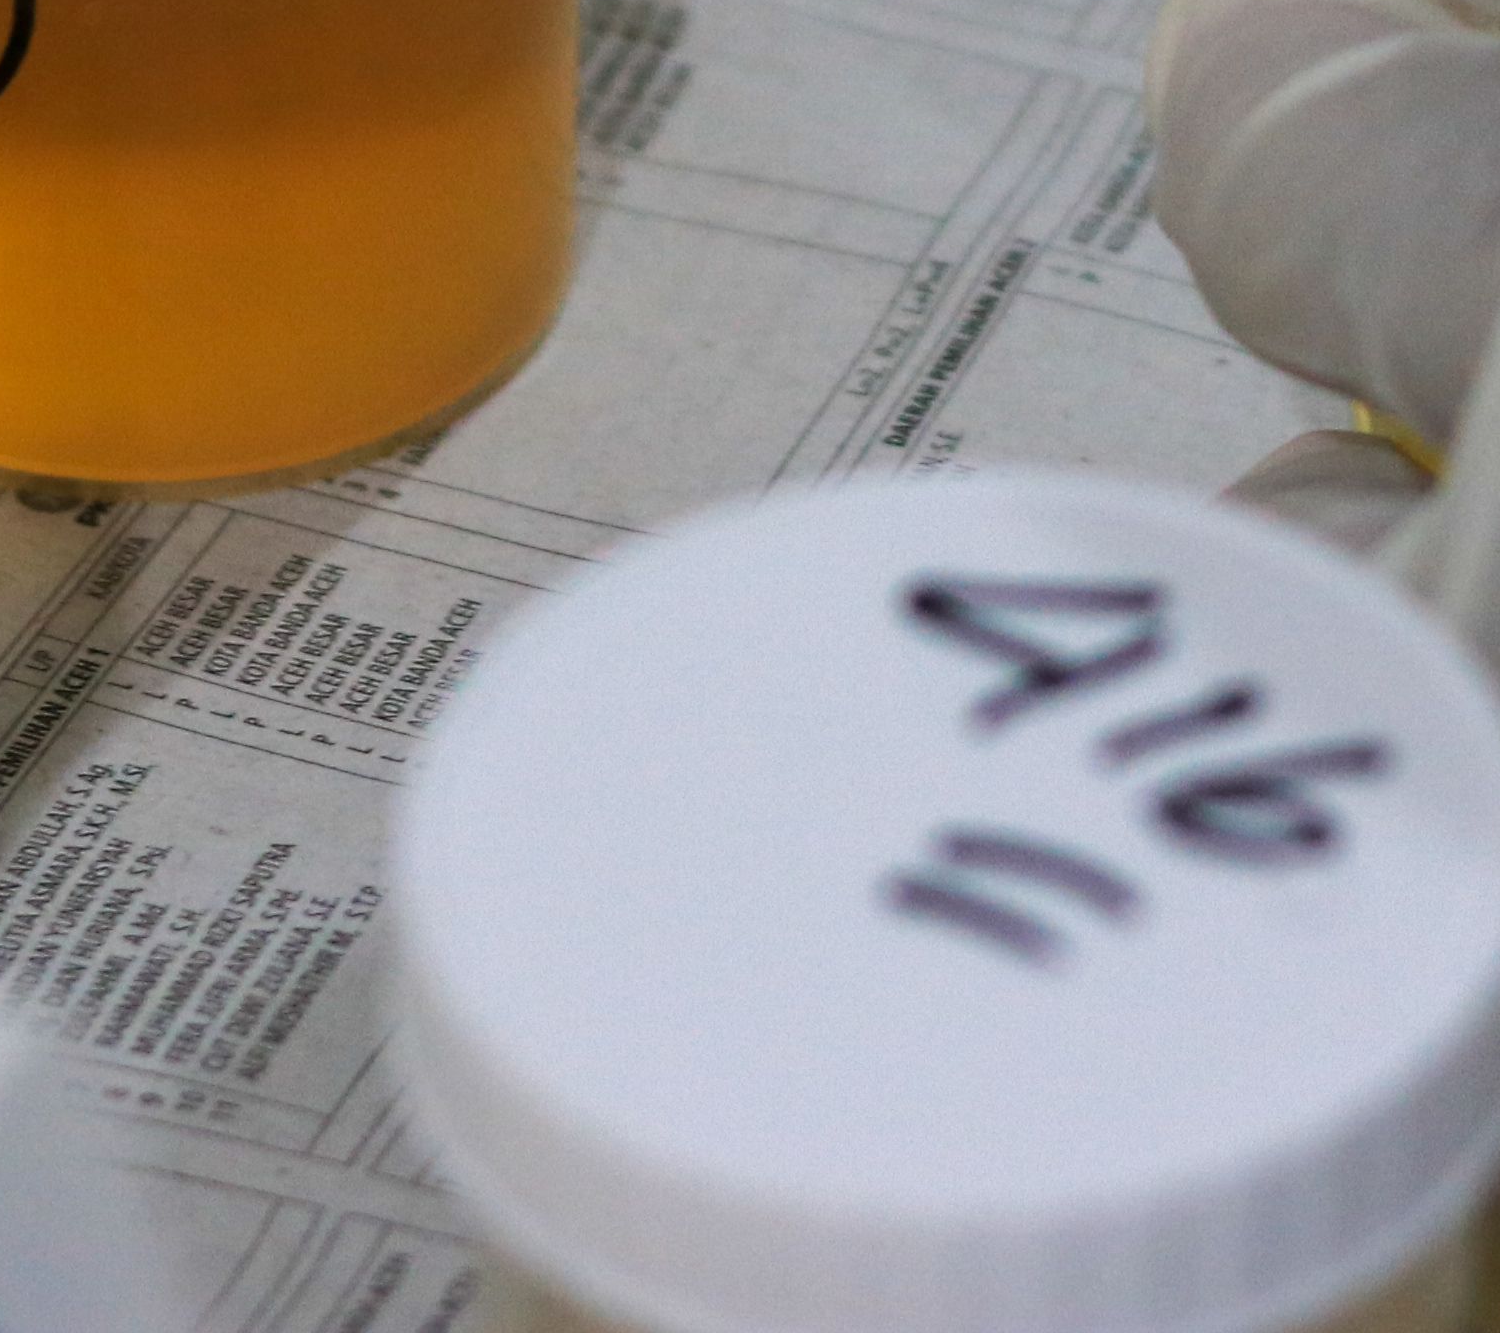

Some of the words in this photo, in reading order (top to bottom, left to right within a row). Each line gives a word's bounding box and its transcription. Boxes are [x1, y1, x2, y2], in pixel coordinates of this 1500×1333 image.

[54, 660, 100, 700] ACEH
[85, 645, 111, 658] 1
[135, 620, 179, 655] ACEH
[165, 576, 214, 617] BESAR
[173, 696, 203, 711] P
[202, 640, 246, 676] KOTA
[230, 592, 283, 638] BANDA
[268, 554, 313, 590] ACEH
[235, 650, 279, 685] KOTA
[264, 601, 317, 647] BANDA
[303, 564, 346, 599] ACEH
[243, 715, 270, 729] P
[269, 658, 313, 694] ACEH
[299, 614, 349, 655] BESAR
[303, 667, 347, 703] ACEH
[334, 623, 383, 664] BESAR
[7, 798, 83, 876] ABDULLAH,
[168, 629, 213, 665] ACEH
[199, 586, 247, 627] BESAR
[308, 732, 338, 747] P
[339, 676, 382, 712] ACEH
[368, 632, 416, 673] BESAR
[900, 573, 1388, 863] 416
[131, 950, 217, 1056] MUHAMMAD
[231, 840, 295, 906] SAPUTRA
[372, 685, 416, 721] KOTA
[401, 637, 453, 684] BANDA
[437, 598, 480, 635] ACEH
